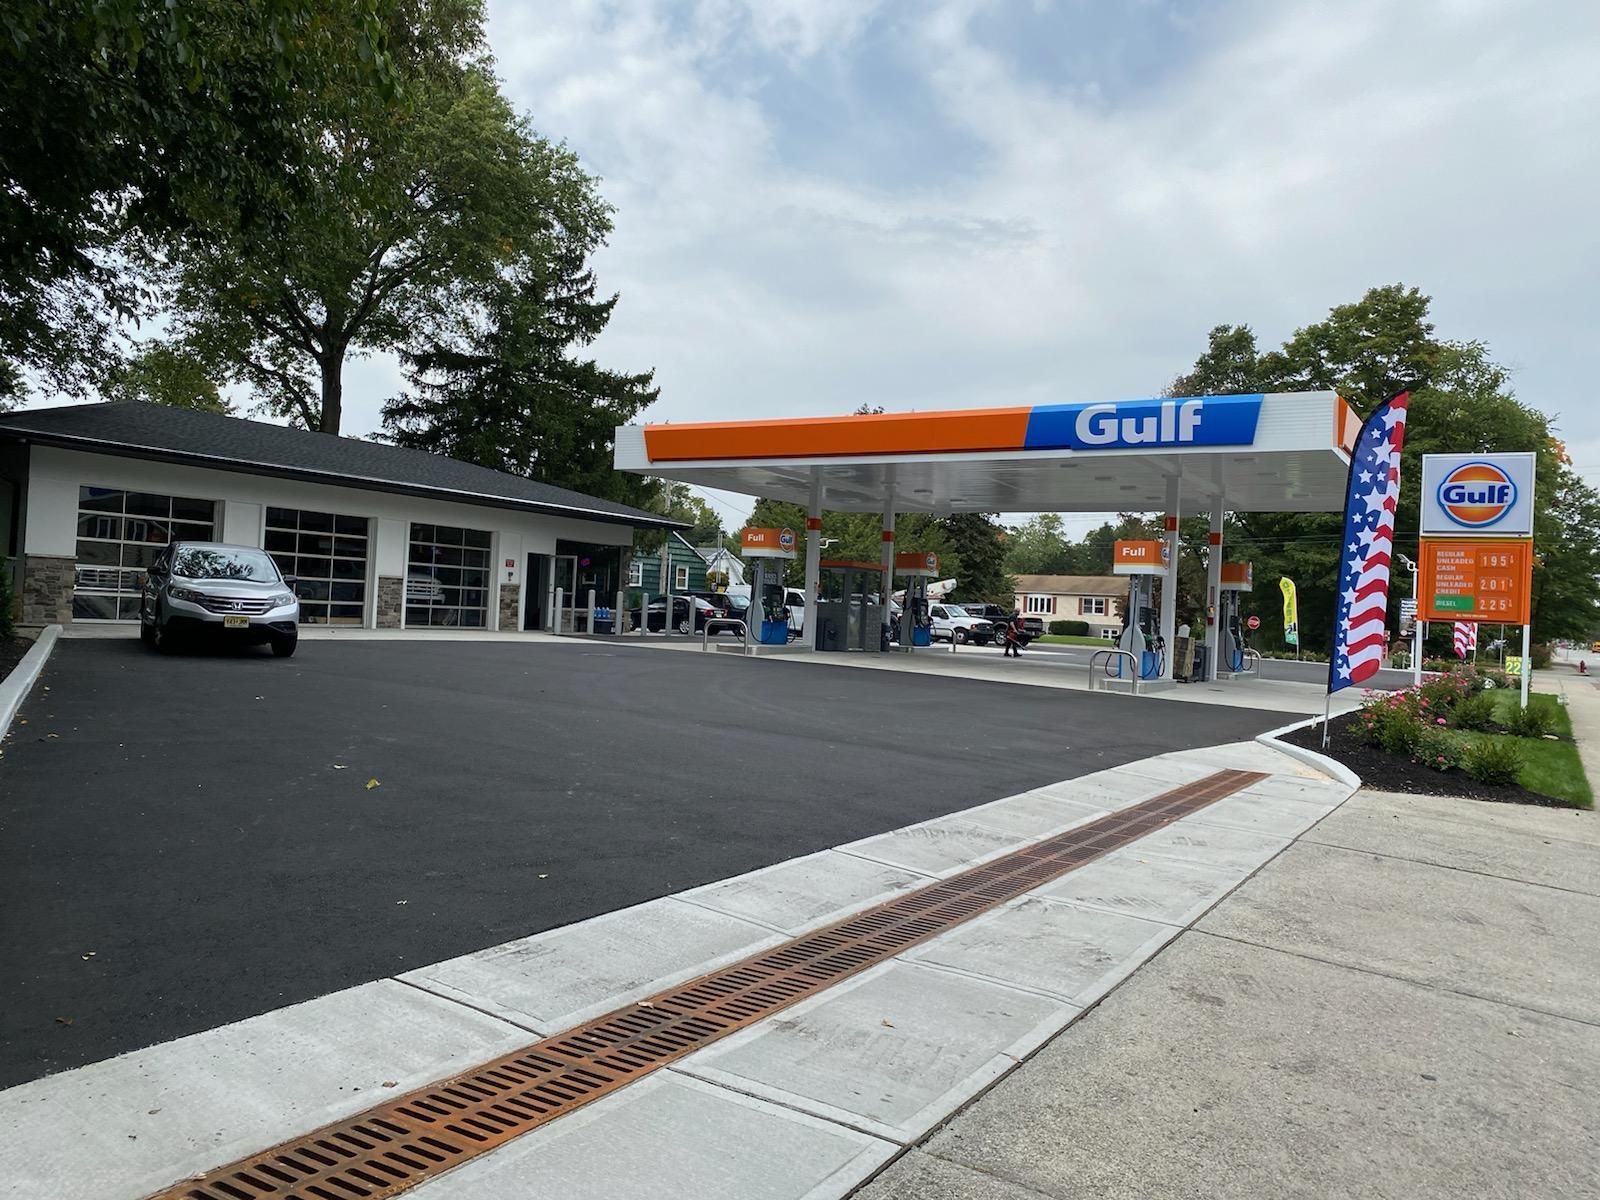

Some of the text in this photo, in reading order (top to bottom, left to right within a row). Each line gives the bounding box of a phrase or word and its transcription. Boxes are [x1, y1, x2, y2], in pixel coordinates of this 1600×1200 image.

[1075, 400, 1203, 445] Gulf
[1443, 485, 1510, 504] Gulf
[747, 533, 765, 542] Full
[1122, 547, 1146, 557] Full
